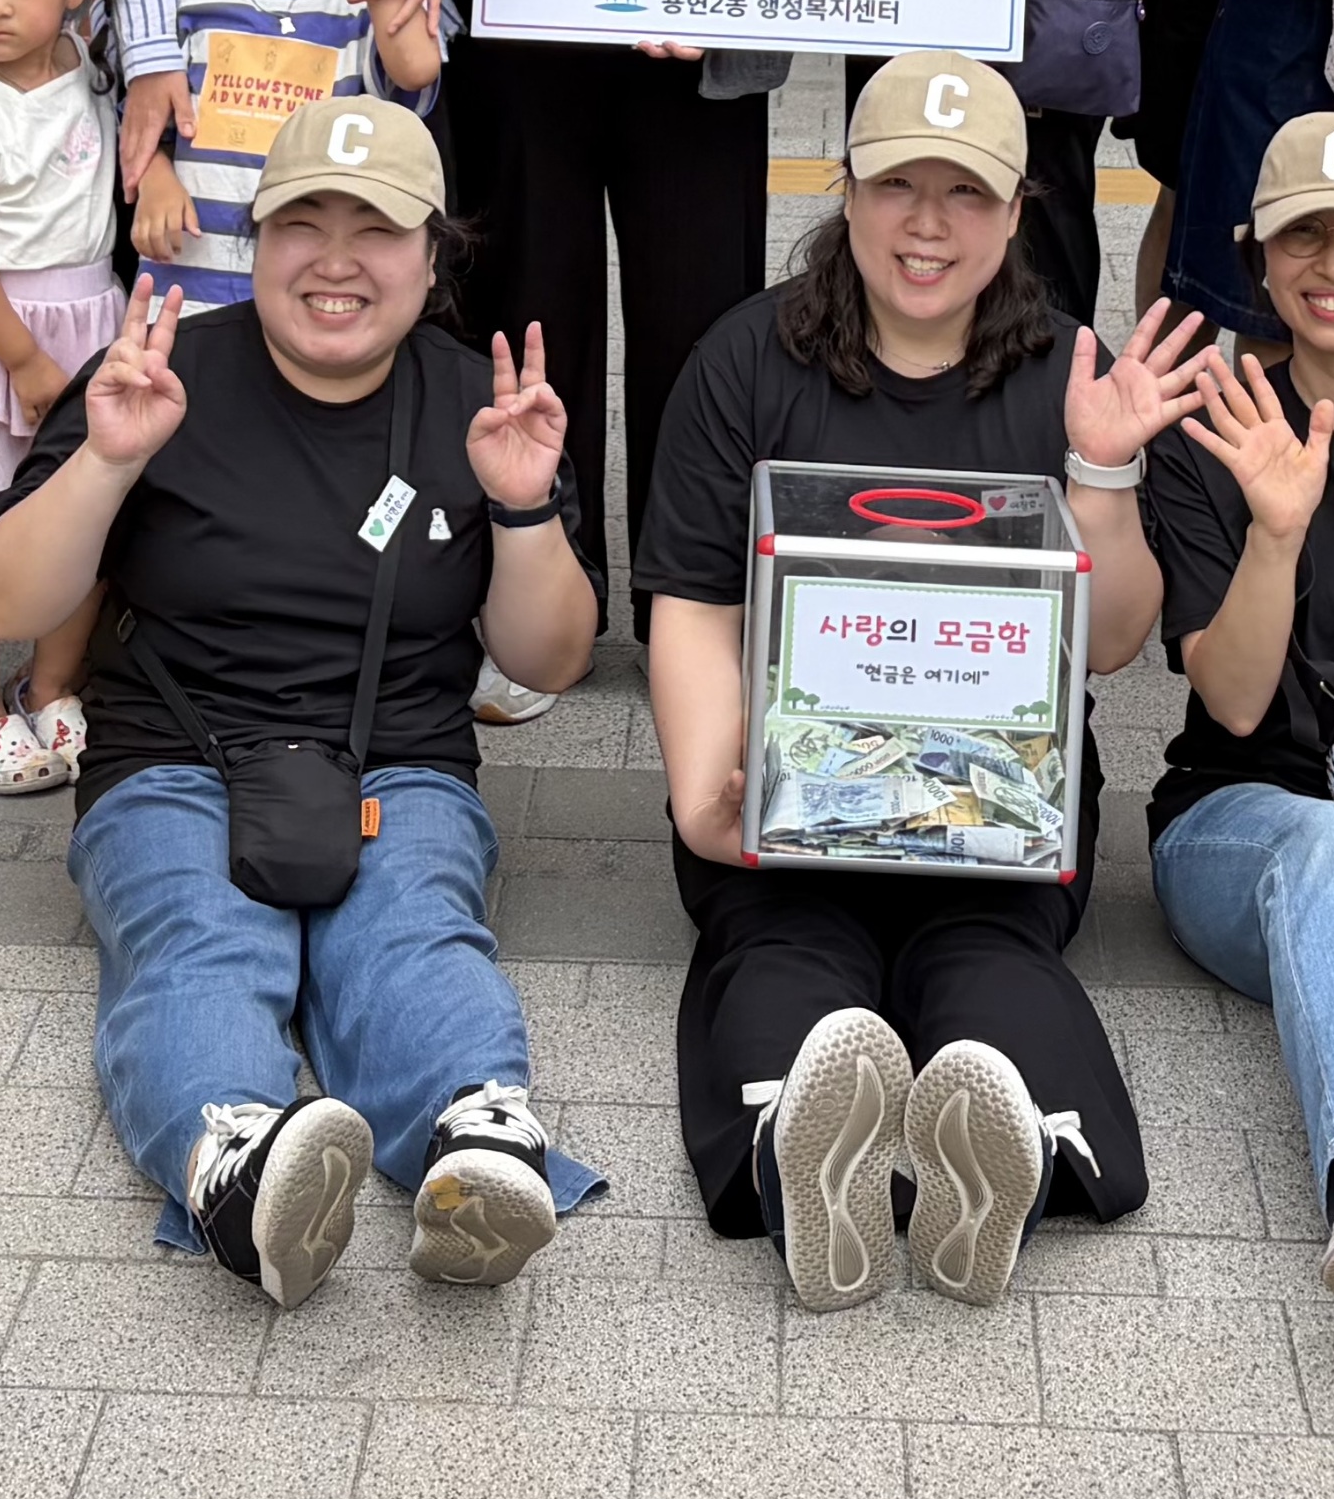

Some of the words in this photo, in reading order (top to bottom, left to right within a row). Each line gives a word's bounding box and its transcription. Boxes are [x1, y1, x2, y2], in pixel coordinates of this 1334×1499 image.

[209, 89, 306, 113] ADVENTU
[212, 73, 324, 101] YELLOWSTONE
[923, 73, 970, 128] C
[327, 113, 374, 166] C
[819, 614, 916, 647] 사랑의
[934, 620, 1030, 654] 모금함
[931, 729, 954, 746] 1000
